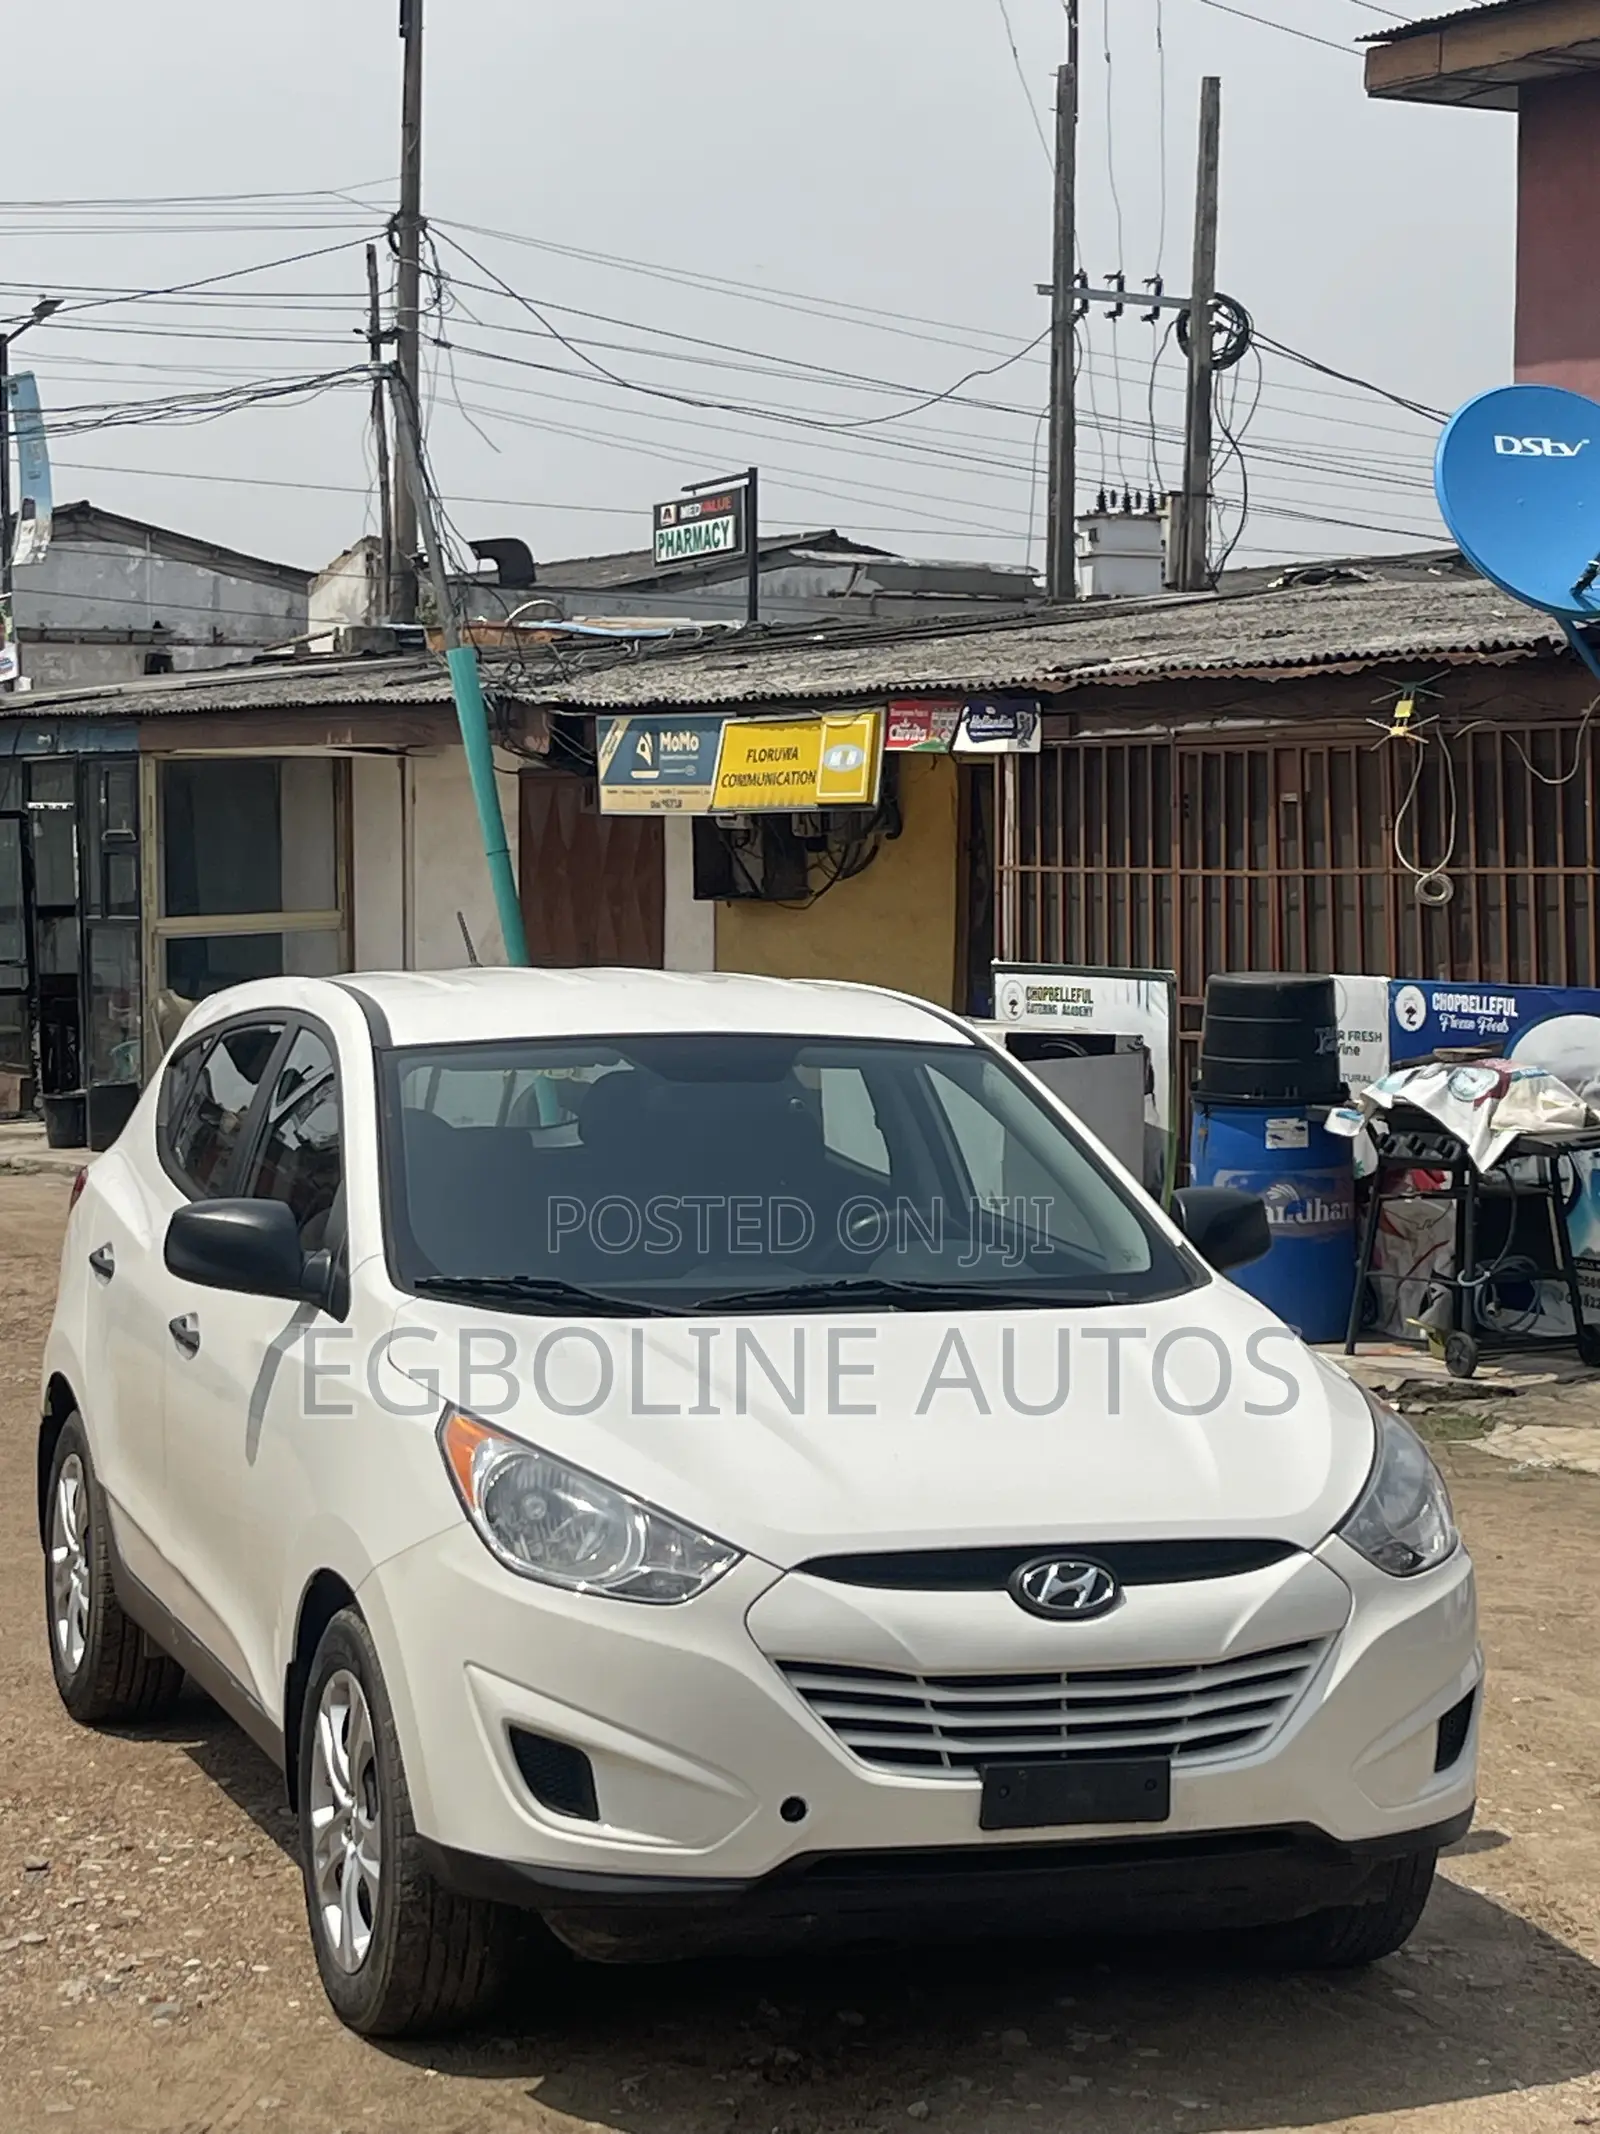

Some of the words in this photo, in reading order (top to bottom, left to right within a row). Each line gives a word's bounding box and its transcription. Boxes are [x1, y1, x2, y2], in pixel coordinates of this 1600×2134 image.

[656, 519, 731, 559] PHARMACY
[659, 731, 700, 752] MoMo
[721, 770, 817, 789] COMMUNICATION
[1432, 992, 1519, 1018] CHOPBELLEFUL
[1347, 1030, 1383, 1043] FRESH
